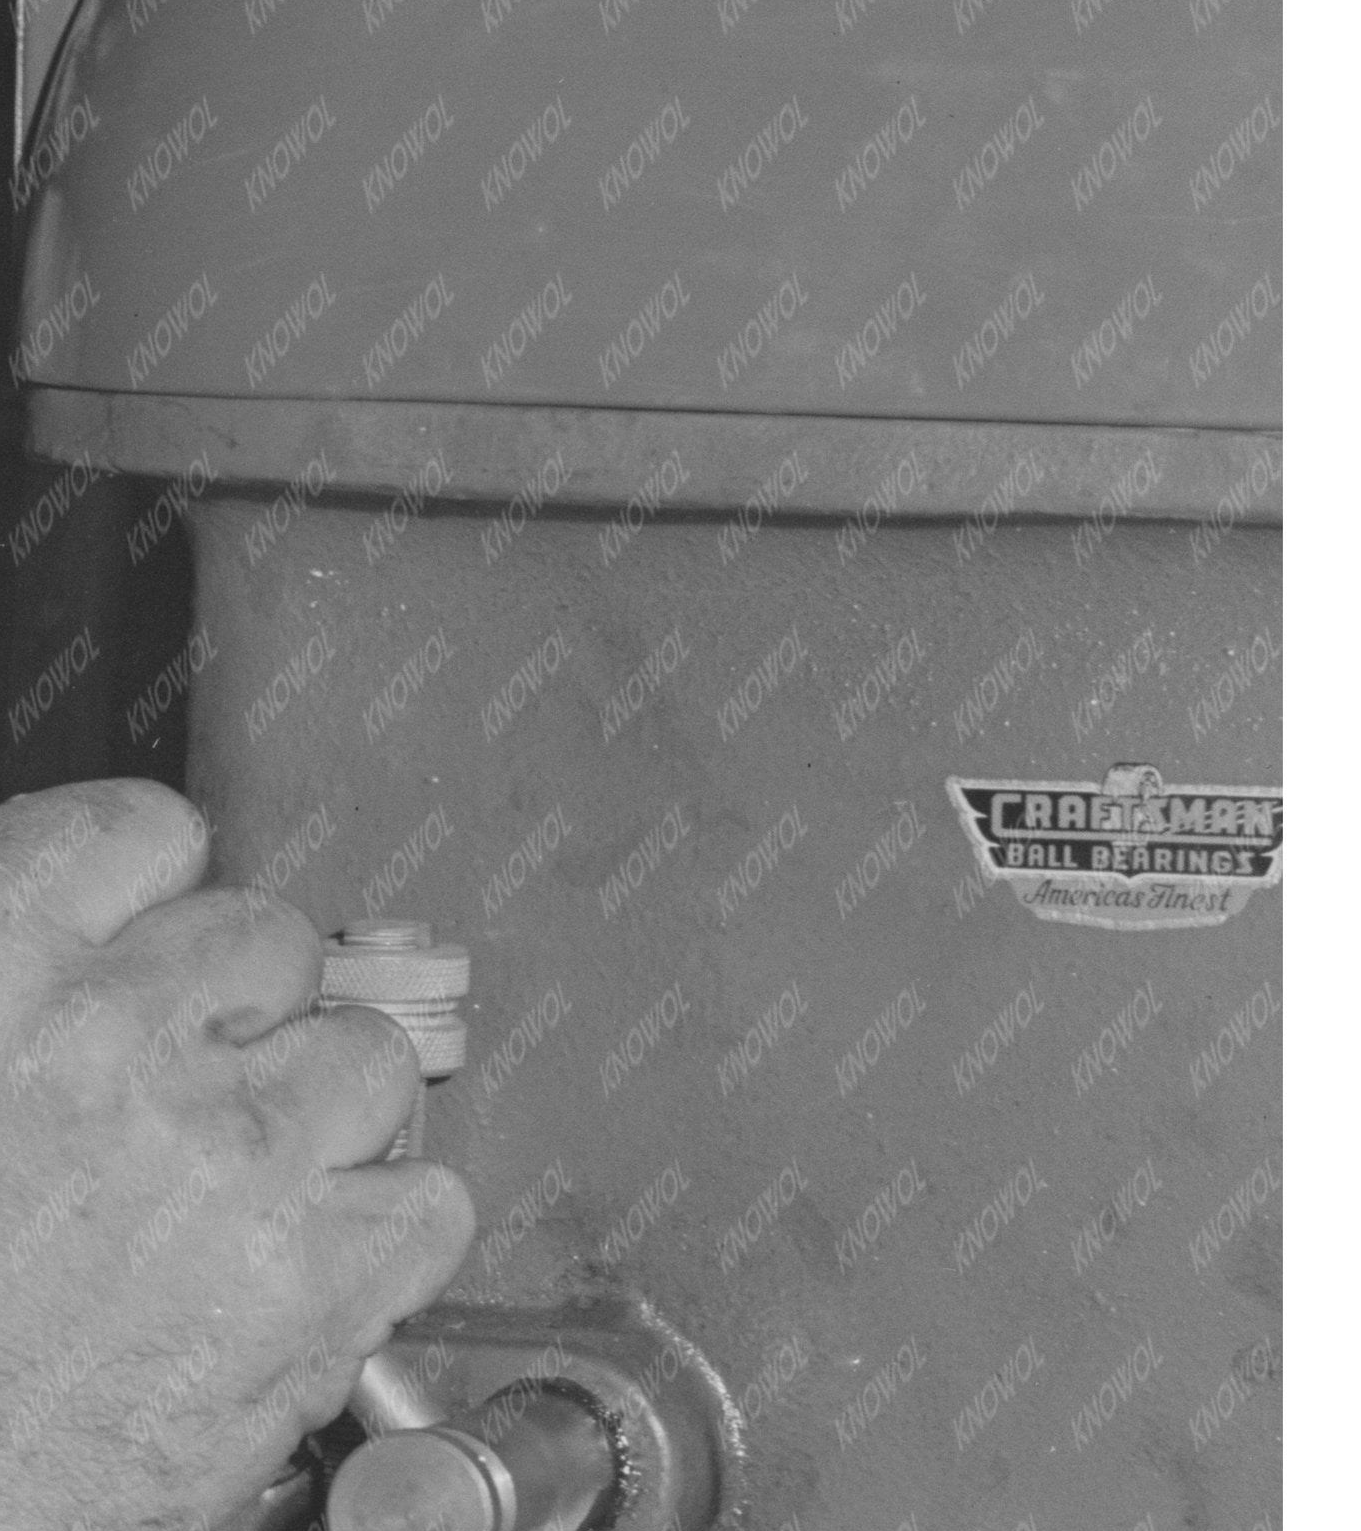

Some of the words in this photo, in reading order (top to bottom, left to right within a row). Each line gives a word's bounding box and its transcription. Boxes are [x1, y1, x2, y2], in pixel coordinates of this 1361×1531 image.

[990, 792, 1278, 839] CRAFTSMAN
[1006, 842, 1078, 868] BALL
[1090, 845, 1254, 874] BEARINGS
[1147, 882, 1232, 911] Finest
